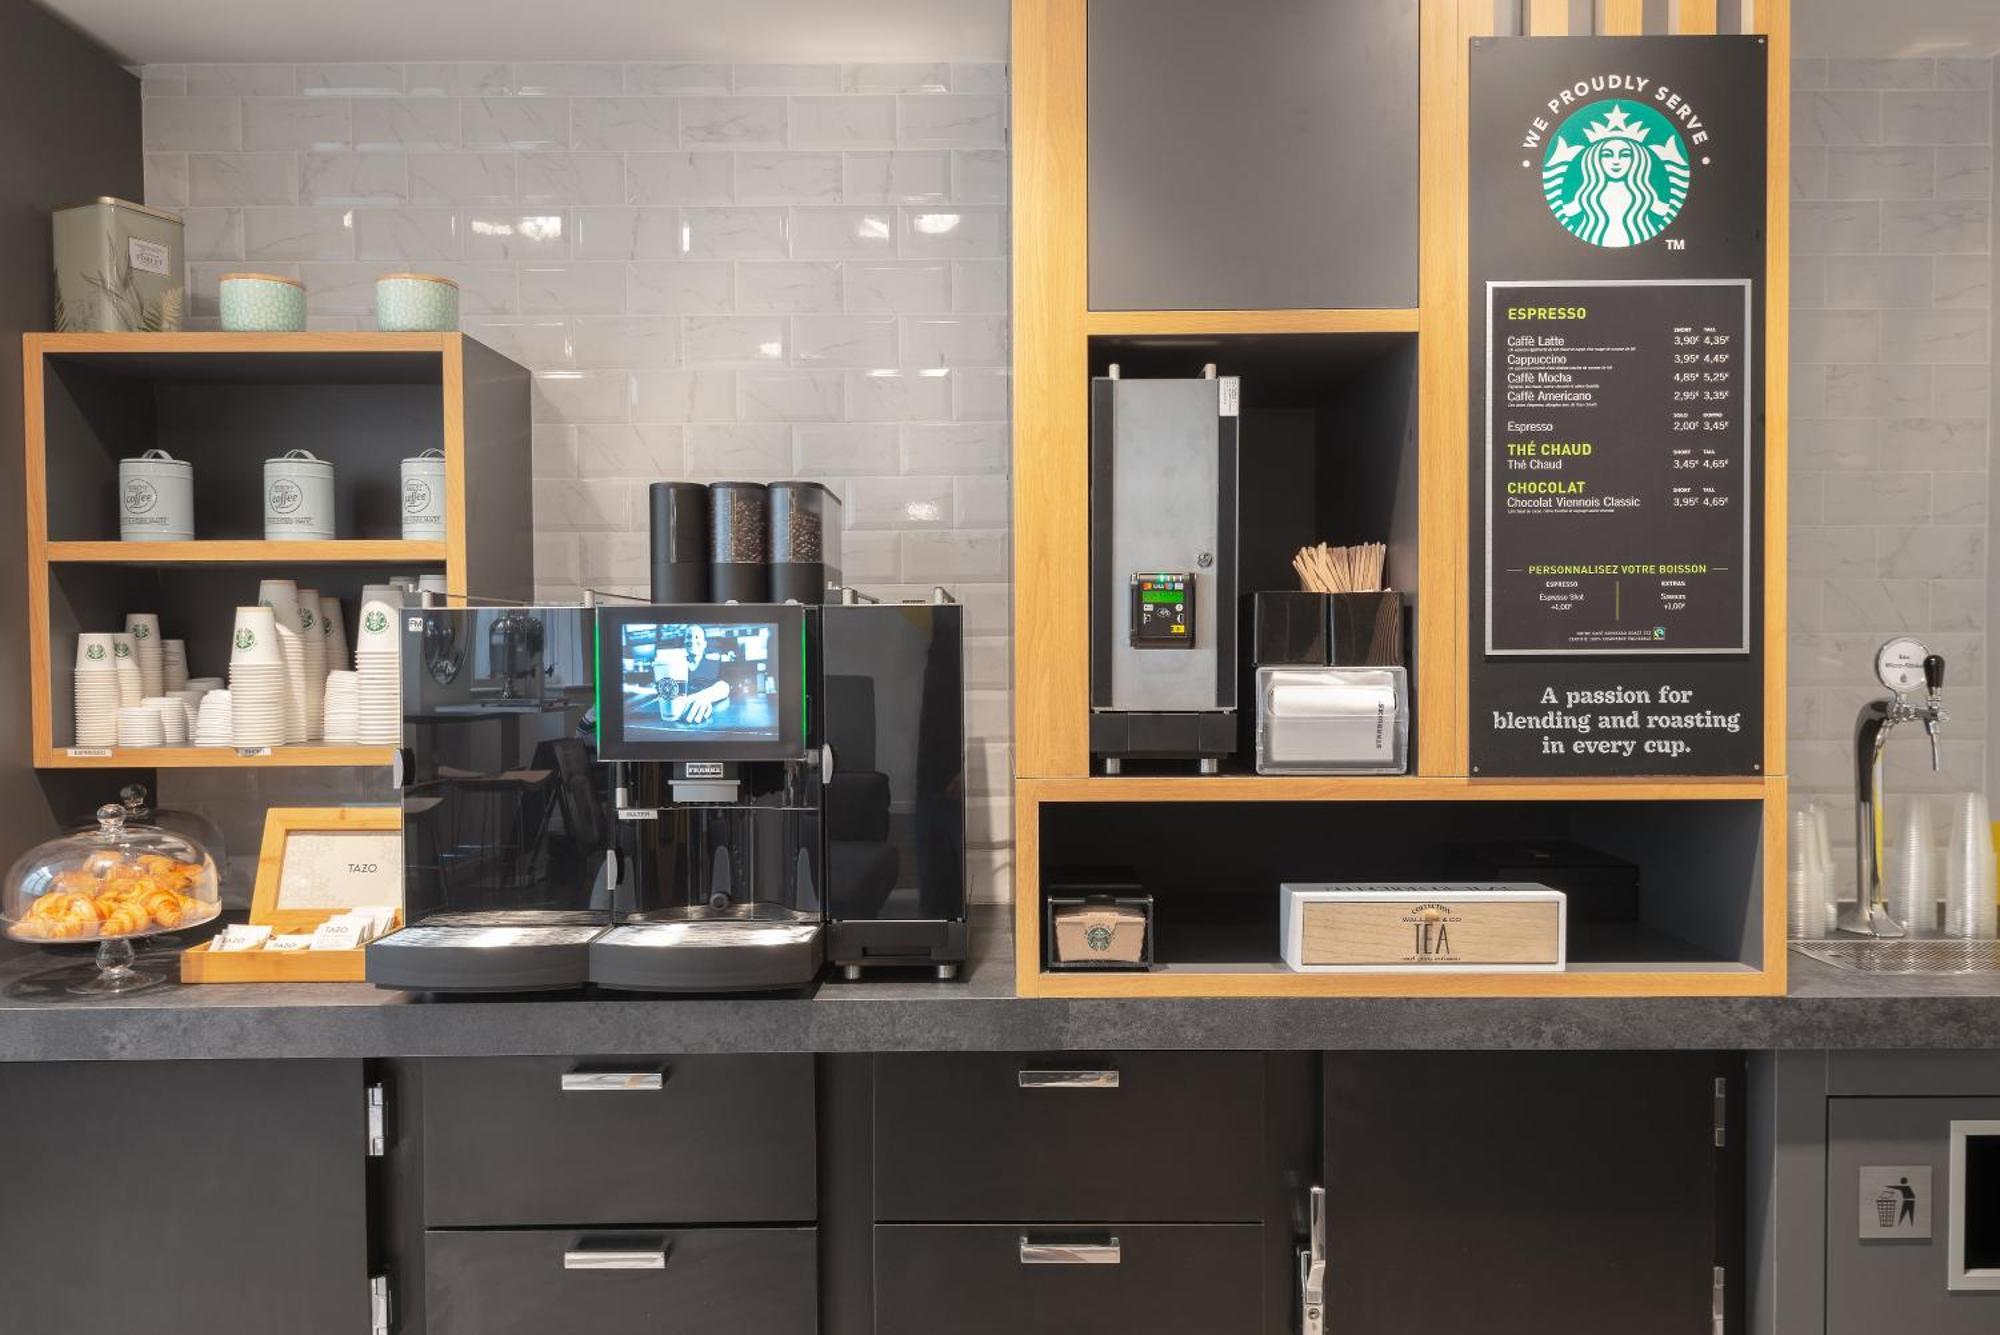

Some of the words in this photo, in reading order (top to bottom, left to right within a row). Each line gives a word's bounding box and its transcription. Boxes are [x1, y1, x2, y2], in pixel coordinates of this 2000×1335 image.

[1521, 116, 1549, 149] WE
[1547, 74, 1649, 114] PROUDLY
[1654, 86, 1708, 145] SERVE
[1665, 239, 1685, 250] TM
[1508, 307, 1586, 320] ESPRESSO
[1507, 336, 1535, 347] Caffè
[1538, 336, 1565, 347] Latte
[1507, 353, 1568, 366] Cappuccino
[1507, 372, 1535, 383] Caffè
[1538, 372, 1572, 383] Mocha
[1507, 390, 1535, 402] Caffè
[1538, 390, 1592, 401] Americano
[1507, 421, 1553, 433] Espresso
[1507, 440, 1537, 456] THÉ
[1541, 443, 1592, 456] CHAUD
[1507, 459, 1527, 470] Thé
[1529, 459, 1562, 470] Chaud
[1507, 481, 1586, 494] CHOCOLAT
[1507, 496, 1552, 508] Chocolat
[1555, 496, 1601, 508] Viennois
[1603, 496, 1641, 507] Classic
[1528, 565, 1618, 575] PERSONNALISEZ
[1620, 564, 1656, 574] VOTRE
[1659, 564, 1707, 574] BOISSON
[1540, 687, 1558, 704] A
[1566, 685, 1651, 708] passion
[1659, 685, 1693, 704] for
[1376, 703, 1385, 750] STARBUCKS
[1493, 710, 1591, 733] blending
[1598, 710, 1640, 729] and
[1646, 710, 1741, 733] roasting
[1542, 736, 1565, 754] in
[1572, 740, 1637, 757] every
[1644, 740, 1692, 757] cup.
[348, 864, 378, 873] TAZO
[1414, 923, 1450, 955] TEA
